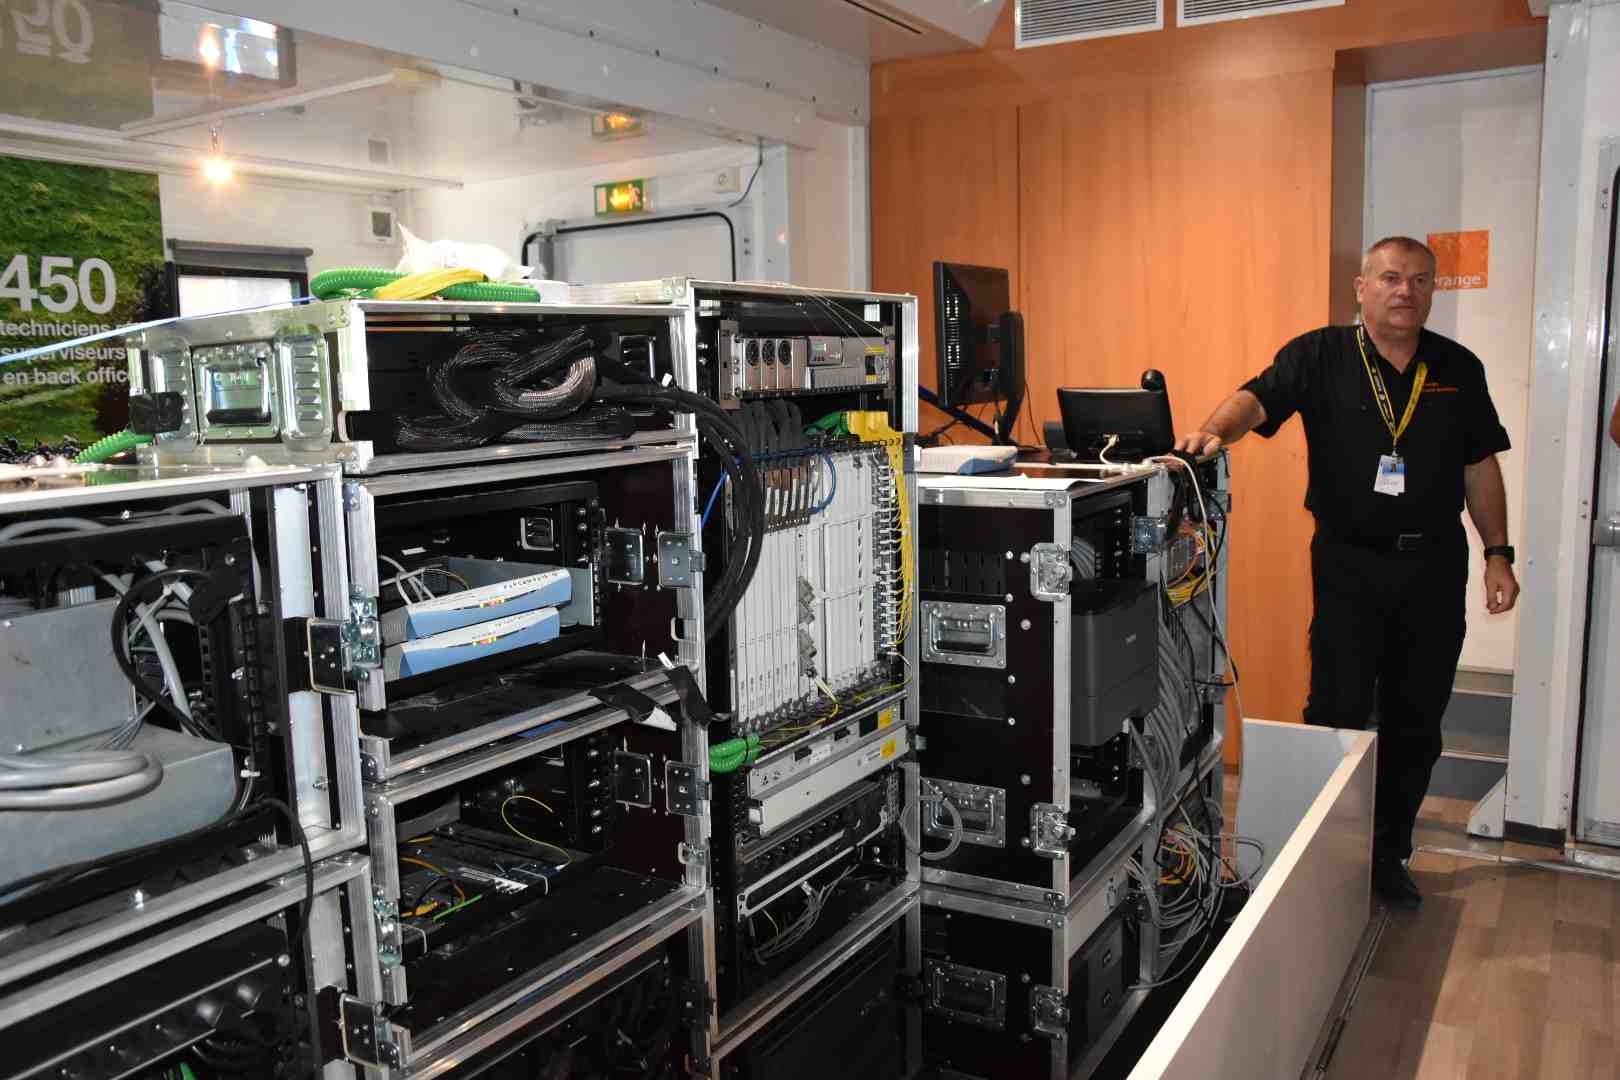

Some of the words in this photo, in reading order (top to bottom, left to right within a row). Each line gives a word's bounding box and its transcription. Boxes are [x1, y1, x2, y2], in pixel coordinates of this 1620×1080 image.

[0, 254, 117, 314] 450
[1434, 274, 1482, 289] range
[0, 319, 112, 337] techniciens
[3, 371, 29, 384] en
[33, 367, 81, 384] back
[86, 366, 129, 384] offic
